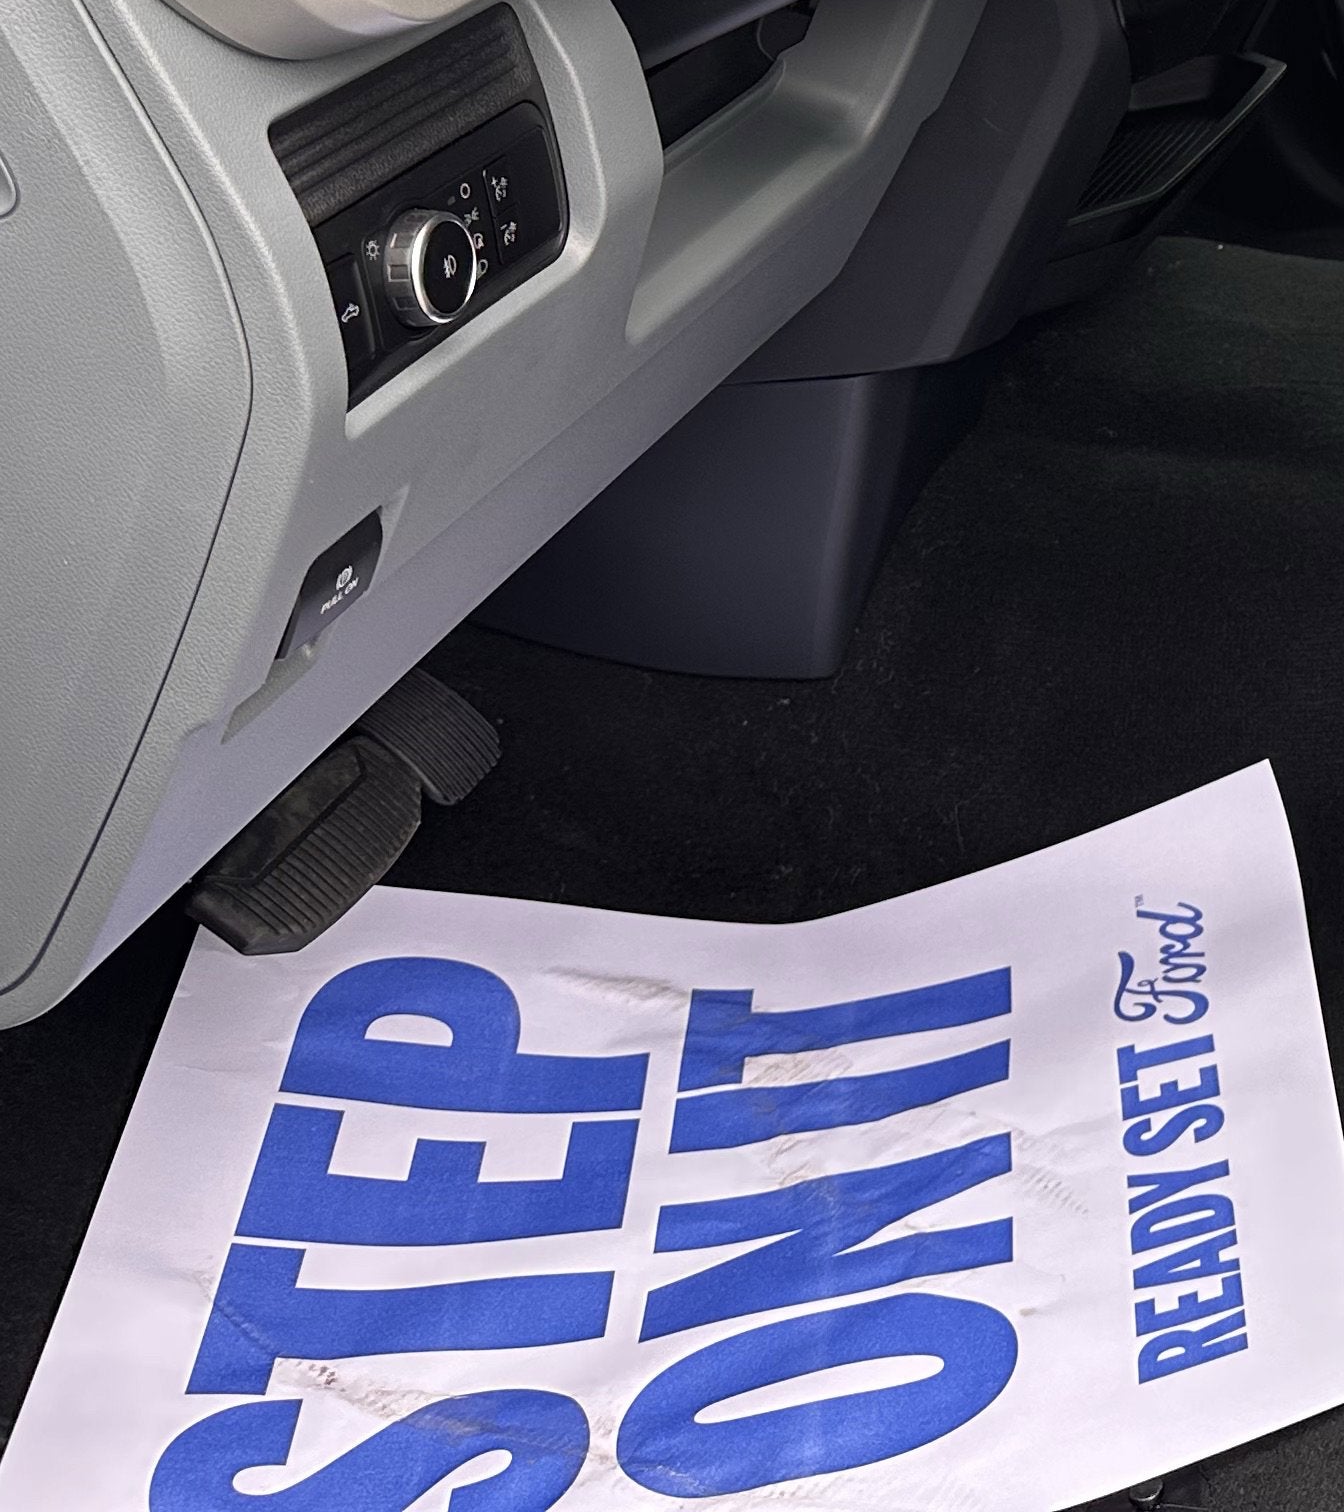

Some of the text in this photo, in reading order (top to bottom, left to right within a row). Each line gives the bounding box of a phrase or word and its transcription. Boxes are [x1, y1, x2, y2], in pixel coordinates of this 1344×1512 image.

[1114, 901, 1209, 1025] Ford
[1117, 1034, 1225, 1156] SET
[149, 957, 650, 1512] STEP
[616, 967, 1018, 1498] ON IT
[1127, 1160, 1248, 1384] READY
